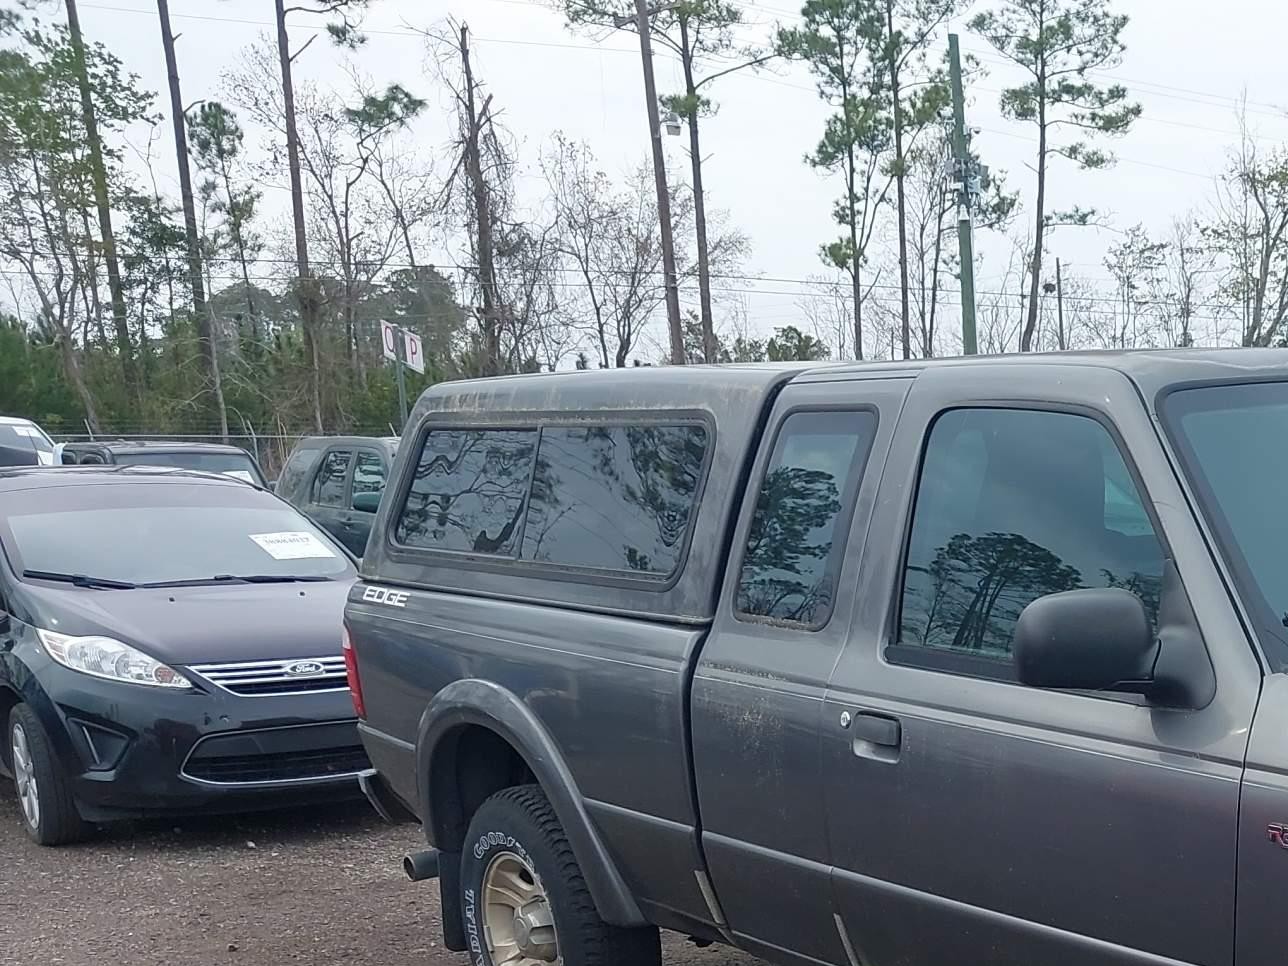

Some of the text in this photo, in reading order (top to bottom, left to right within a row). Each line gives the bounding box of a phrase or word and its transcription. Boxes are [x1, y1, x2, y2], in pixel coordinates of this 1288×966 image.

[410, 337, 418, 365] P
[363, 586, 411, 607] EDGE
[474, 832, 535, 873] GOOD
